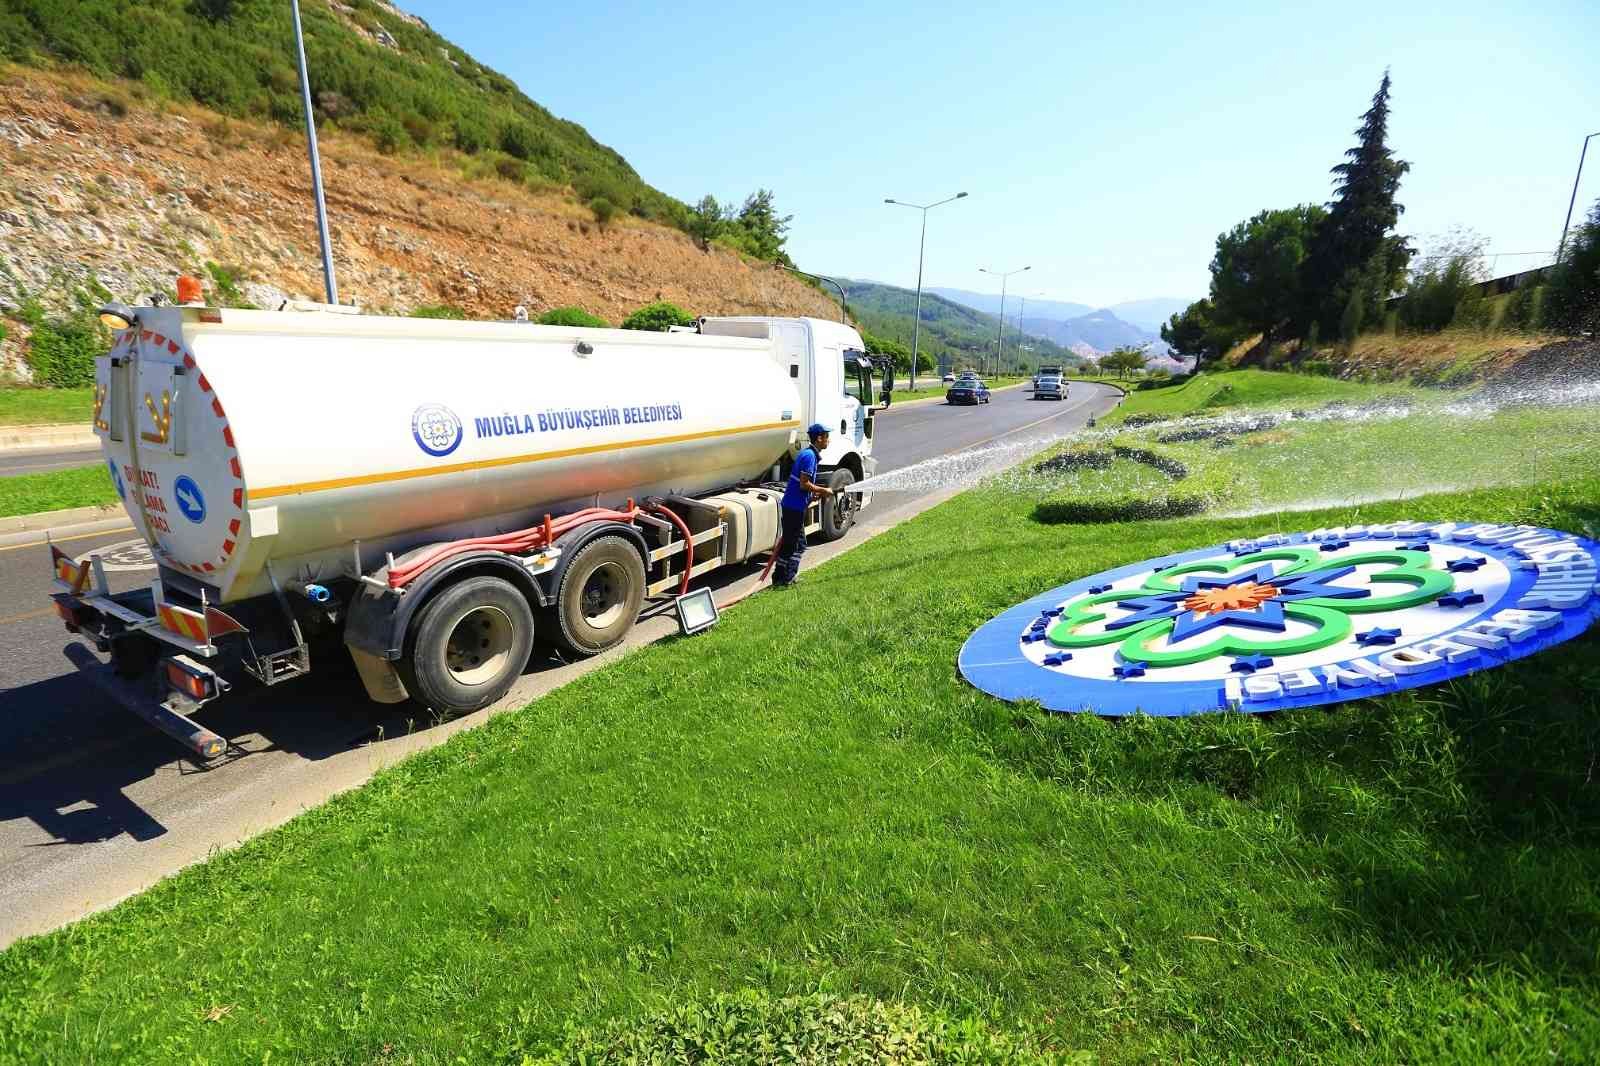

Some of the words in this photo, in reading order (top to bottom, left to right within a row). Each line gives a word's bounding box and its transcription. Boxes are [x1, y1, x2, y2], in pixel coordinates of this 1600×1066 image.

[474, 412, 535, 439] MUĞLA
[537, 406, 621, 432] BÜYÜKŞEHİR
[623, 402, 683, 424] BELEDİYESİ
